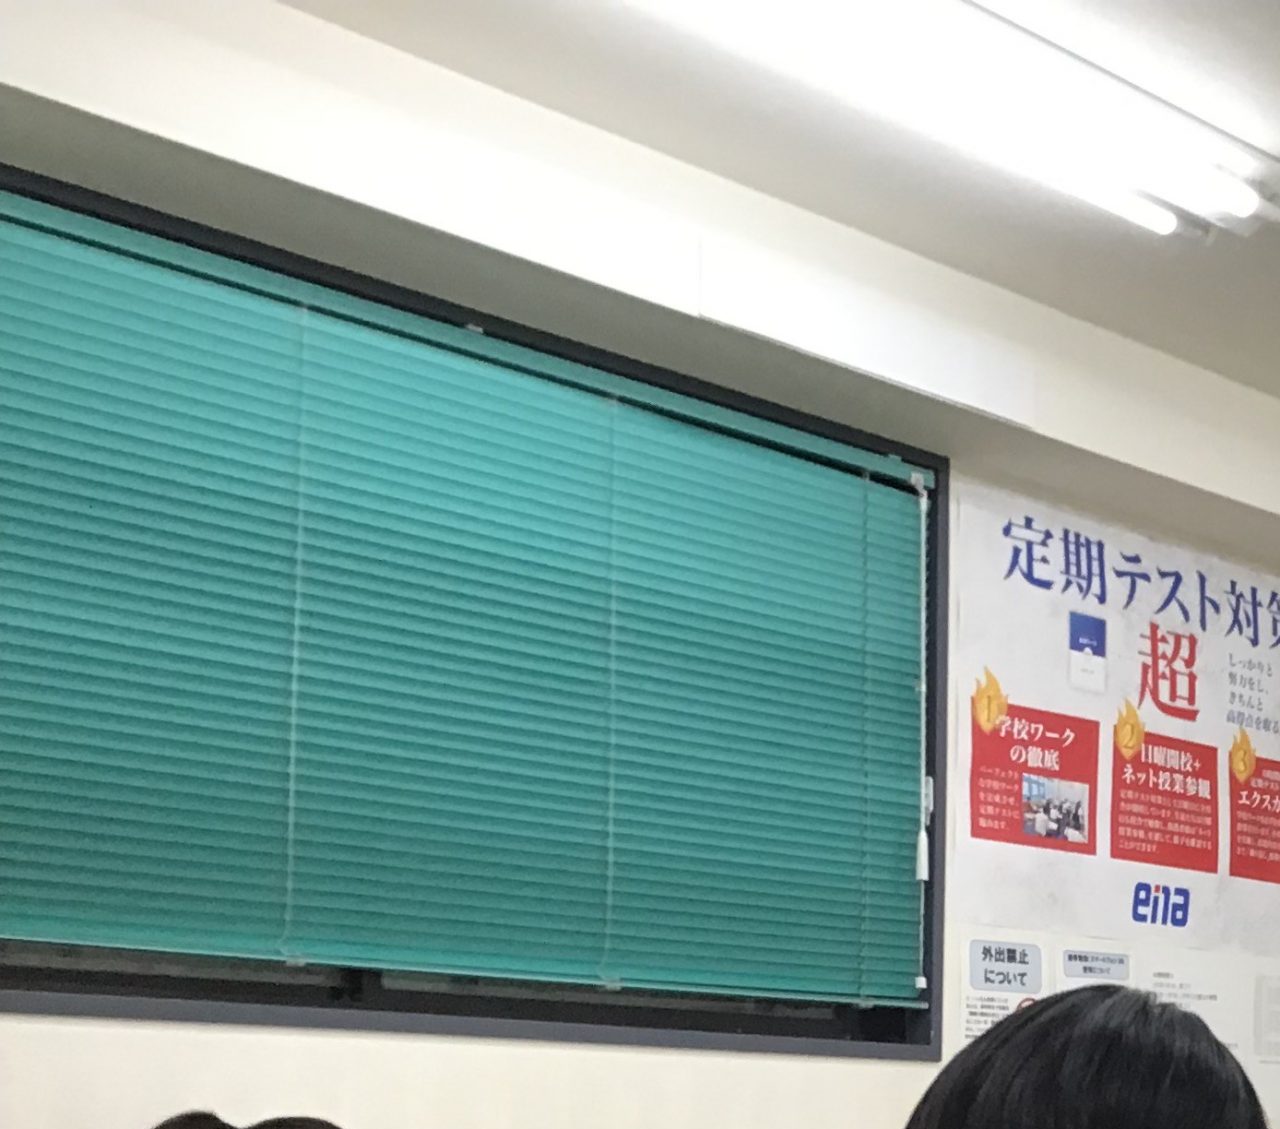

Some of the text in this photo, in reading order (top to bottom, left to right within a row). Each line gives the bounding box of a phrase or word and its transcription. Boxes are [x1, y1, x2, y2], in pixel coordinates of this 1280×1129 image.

[1137, 620, 1200, 722] 超
[1228, 652, 1273, 678] しっかりと
[1229, 690, 1263, 712] きちんと
[995, 715, 1076, 748] 学校ワーク
[1009, 744, 1060, 771] の徹底
[1121, 763, 1212, 800] ネット授業参観
[981, 945, 1030, 966] 外出禁止
[983, 968, 1028, 987] について
